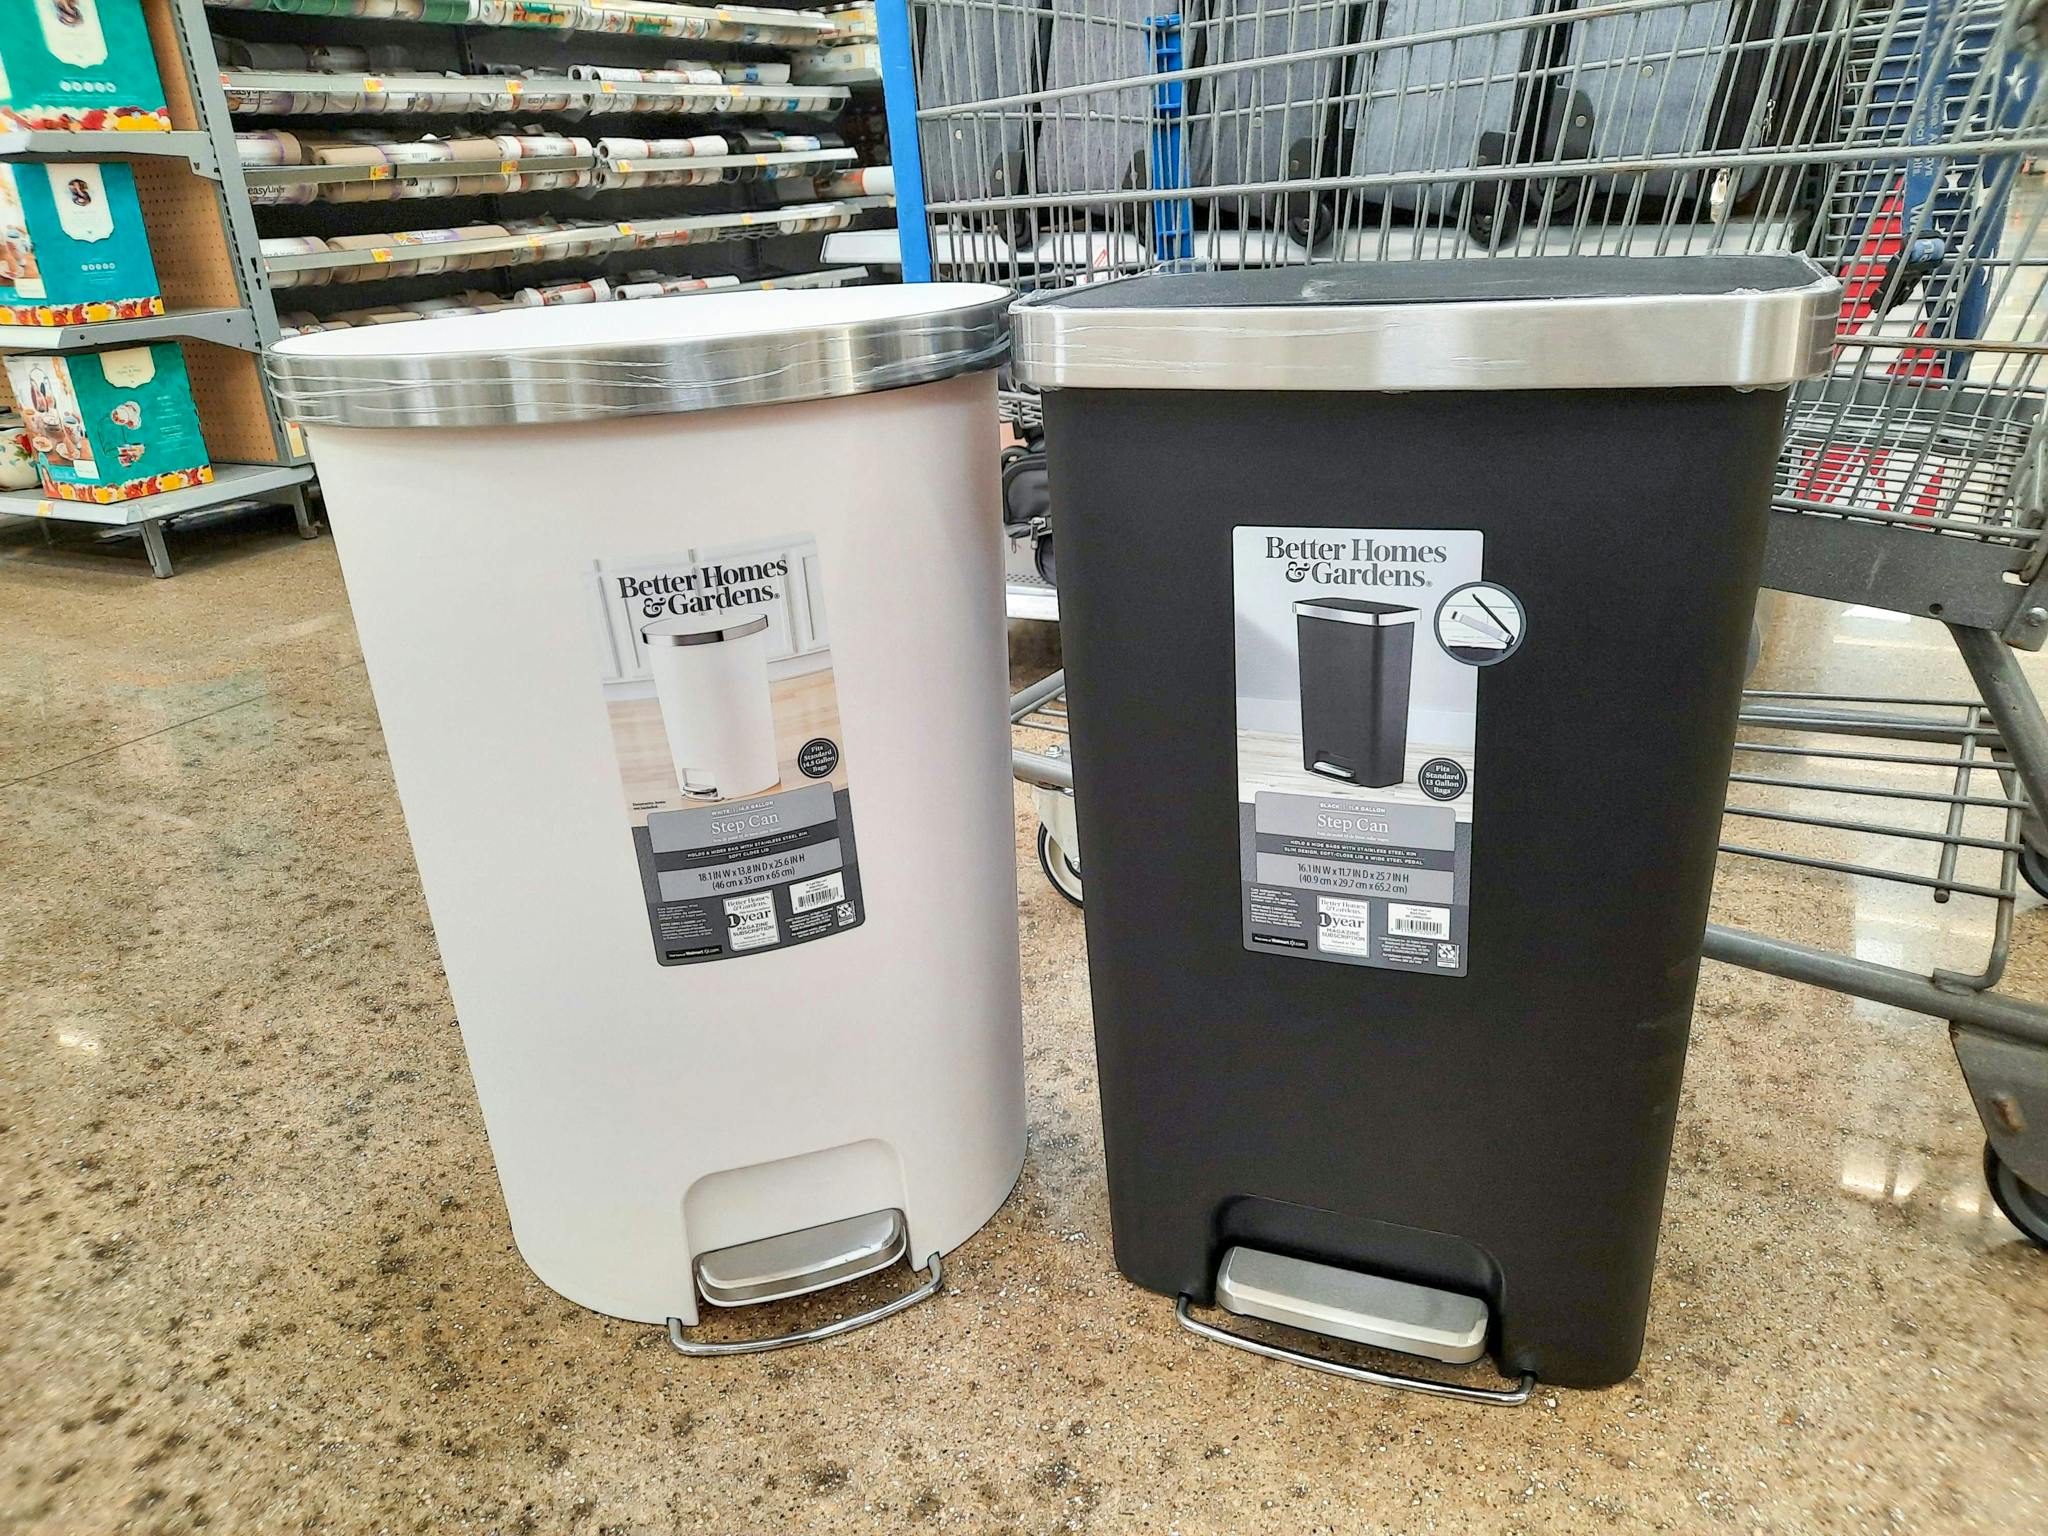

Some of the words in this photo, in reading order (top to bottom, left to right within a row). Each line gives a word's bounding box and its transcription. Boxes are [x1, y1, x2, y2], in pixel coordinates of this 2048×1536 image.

[1265, 536, 1346, 561] Better
[1352, 538, 1447, 563] Homes
[616, 573, 697, 599] Better
[700, 559, 788, 589] Homes
[803, 749, 832, 761] Standard
[811, 745, 823, 753] Fits
[815, 756, 835, 765] Gallon
[812, 765, 828, 773] Bags
[1425, 772, 1460, 780] Standard
[1433, 786, 1451, 795] Bags
[750, 801, 774, 809] GALLON
[711, 820, 745, 834] Step
[748, 813, 779, 828] Can
[1317, 813, 1353, 833] Step
[1356, 817, 1389, 833] Can
[728, 852, 742, 860] SOFT
[1357, 846, 1387, 854] STAINLESS
[698, 872, 712, 882] 18.1
[713, 870, 721, 880] IN
[722, 869, 731, 878] W
[737, 865, 752, 876] 13.8
[752, 863, 761, 873] IN
[761, 862, 768, 871] D
[774, 857, 790, 869] 25.6
[789, 855, 798, 865] IN
[798, 853, 805, 862] H
[1297, 863, 1311, 873] 16.1
[1312, 864, 1321, 874] IN
[1322, 865, 1331, 875] W
[1338, 867, 1352, 877] 11.7
[1352, 868, 1361, 878] IN
[1362, 869, 1369, 879] D
[1392, 872, 1401, 882] IN
[1402, 873, 1409, 883] H
[712, 880, 725, 891] (46
[726, 880, 738, 888] cm
[743, 875, 753, 885] 35
[753, 874, 765, 883] cm
[771, 869, 781, 879] 65
[781, 866, 796, 877] cm)
[1299, 873, 1319, 884] (40.9
[1320, 877, 1332, 886] cm
[1338, 878, 1355, 888] 29.7
[1355, 882, 1368, 890] cm
[1374, 882, 1391, 892] 65.2
[1392, 884, 1408, 895] cm)
[740, 910, 771, 926] year
[1332, 917, 1365, 929] year
[732, 925, 774, 937] SUBSCRIPTION
[737, 921, 769, 931] MAGAZINE
